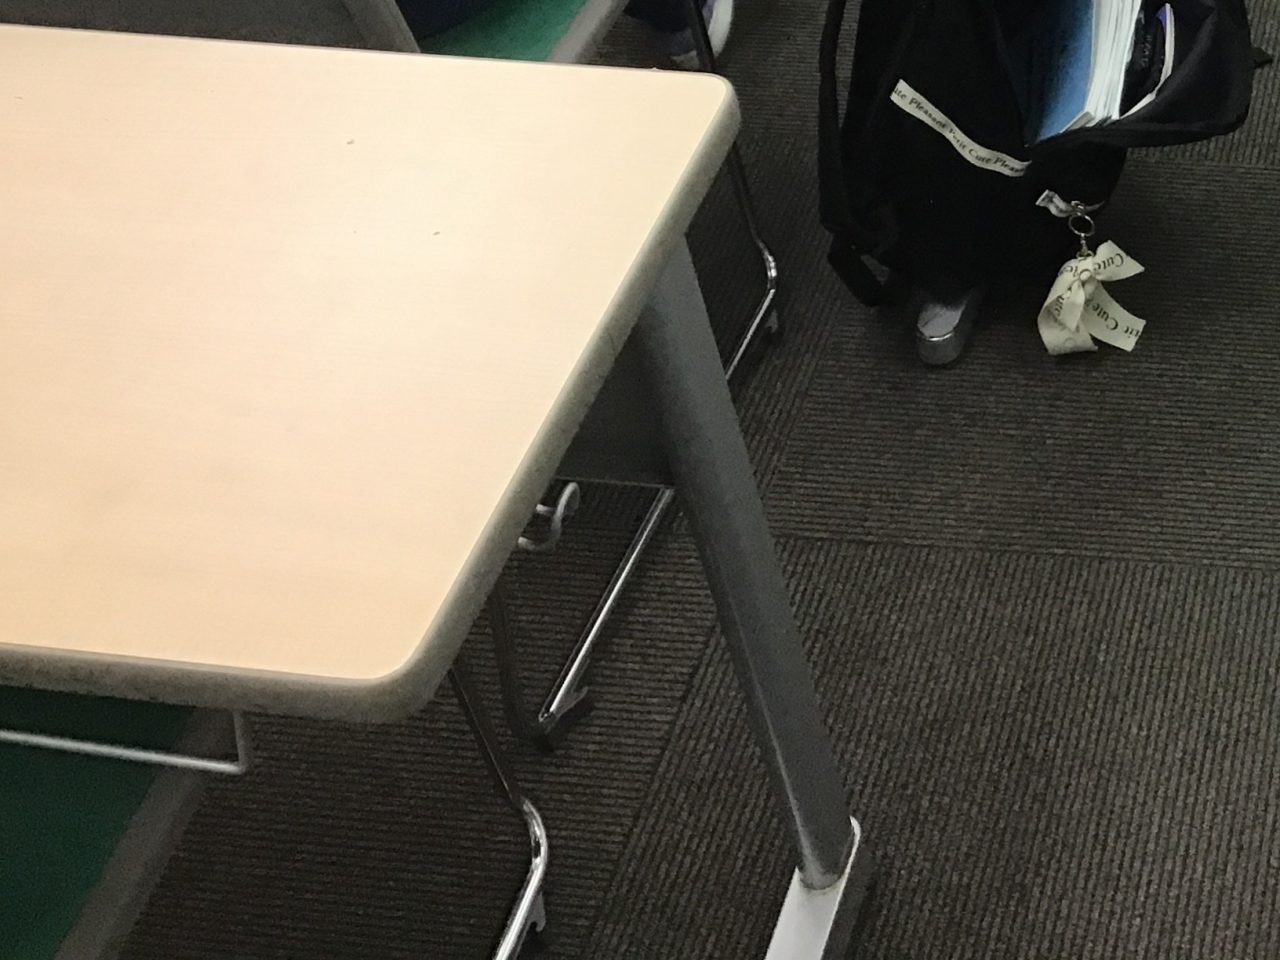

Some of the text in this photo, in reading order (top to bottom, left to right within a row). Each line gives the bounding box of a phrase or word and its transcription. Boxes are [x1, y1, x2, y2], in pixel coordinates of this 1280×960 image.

[968, 147, 992, 164] Cute
[1094, 253, 1125, 271] Cute
[1092, 303, 1119, 331] Cute
